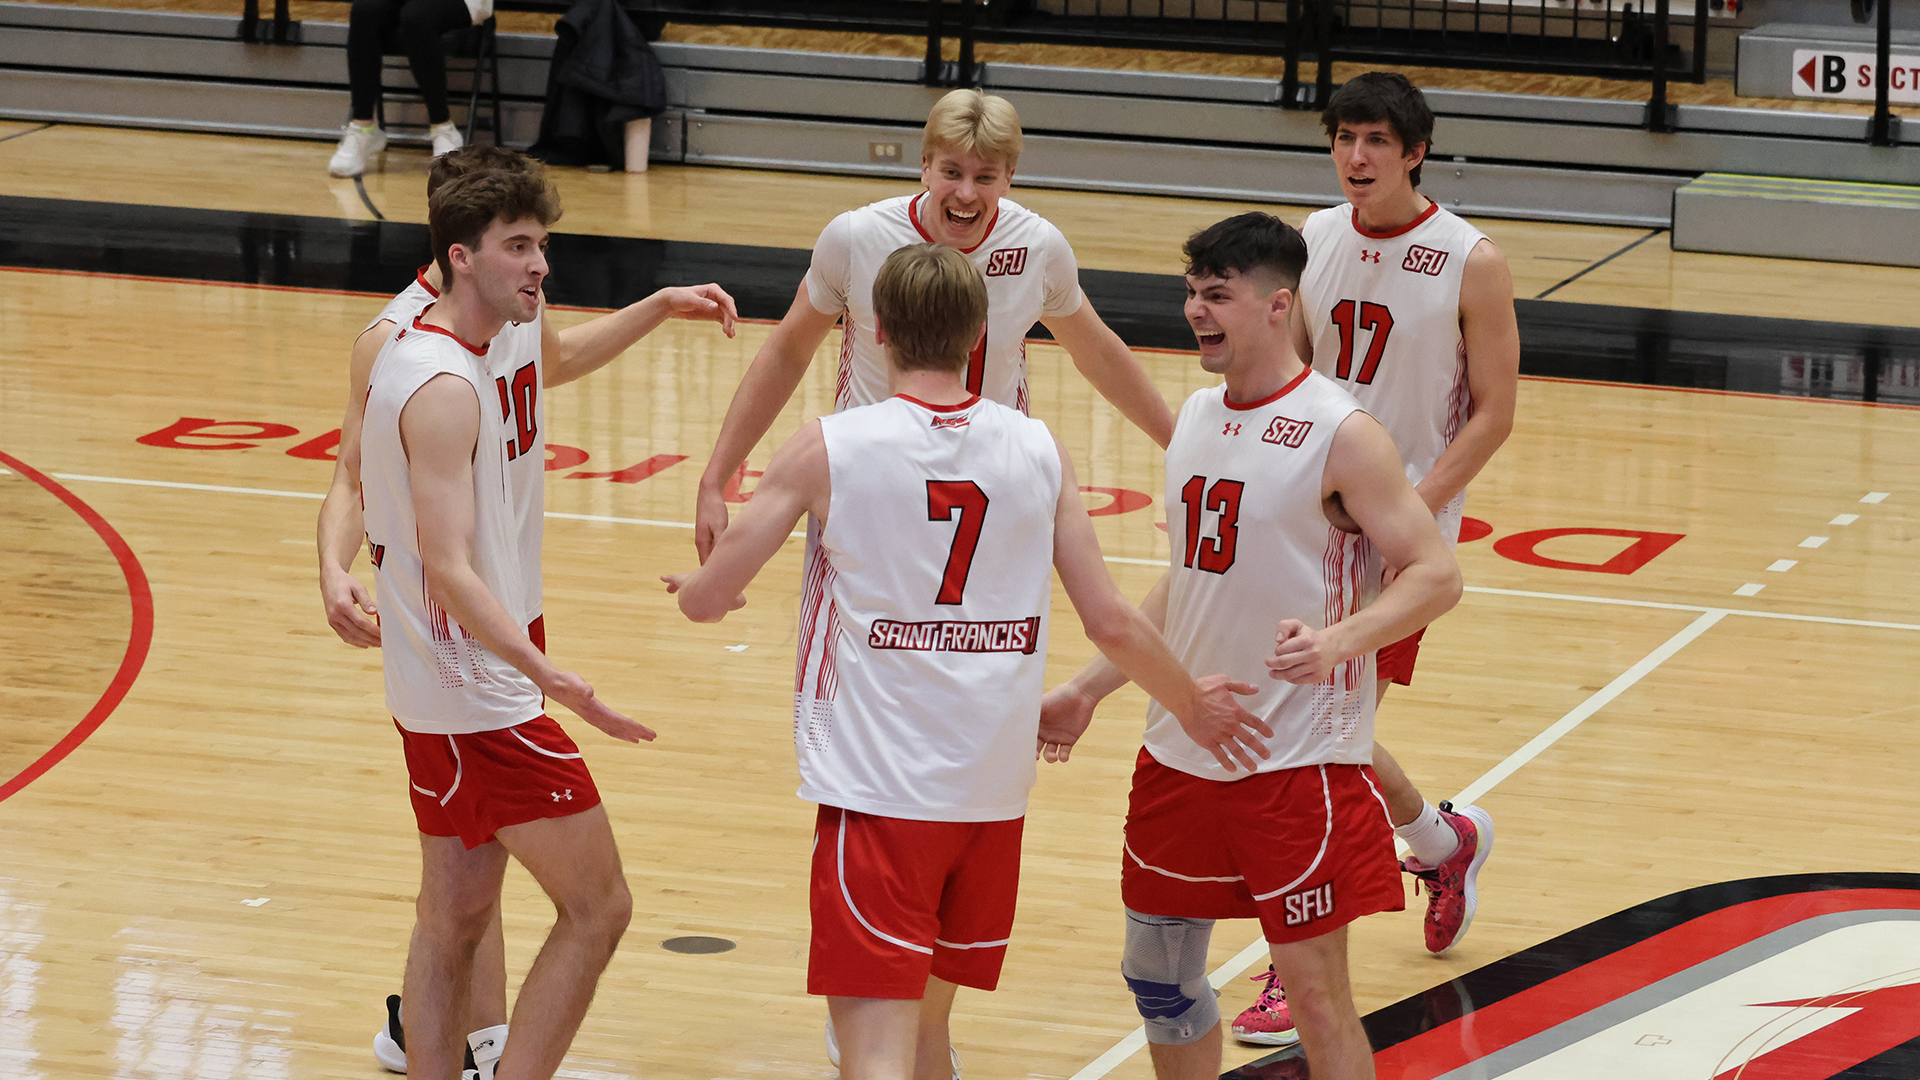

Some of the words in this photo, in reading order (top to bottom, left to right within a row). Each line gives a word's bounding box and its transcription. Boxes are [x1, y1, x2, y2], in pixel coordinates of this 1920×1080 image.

[1822, 55, 1846, 93] B
[1858, 65, 1920, 91] SCT
[986, 247, 1028, 277] SFU
[1403, 245, 1448, 276] SFU
[1331, 299, 1394, 385] 17
[1261, 416, 1314, 448] SFU
[926, 480, 990, 605] 7
[1181, 475, 1245, 575] 13
[869, 619, 938, 651] SAINT
[1284, 880, 1335, 927] SFU
